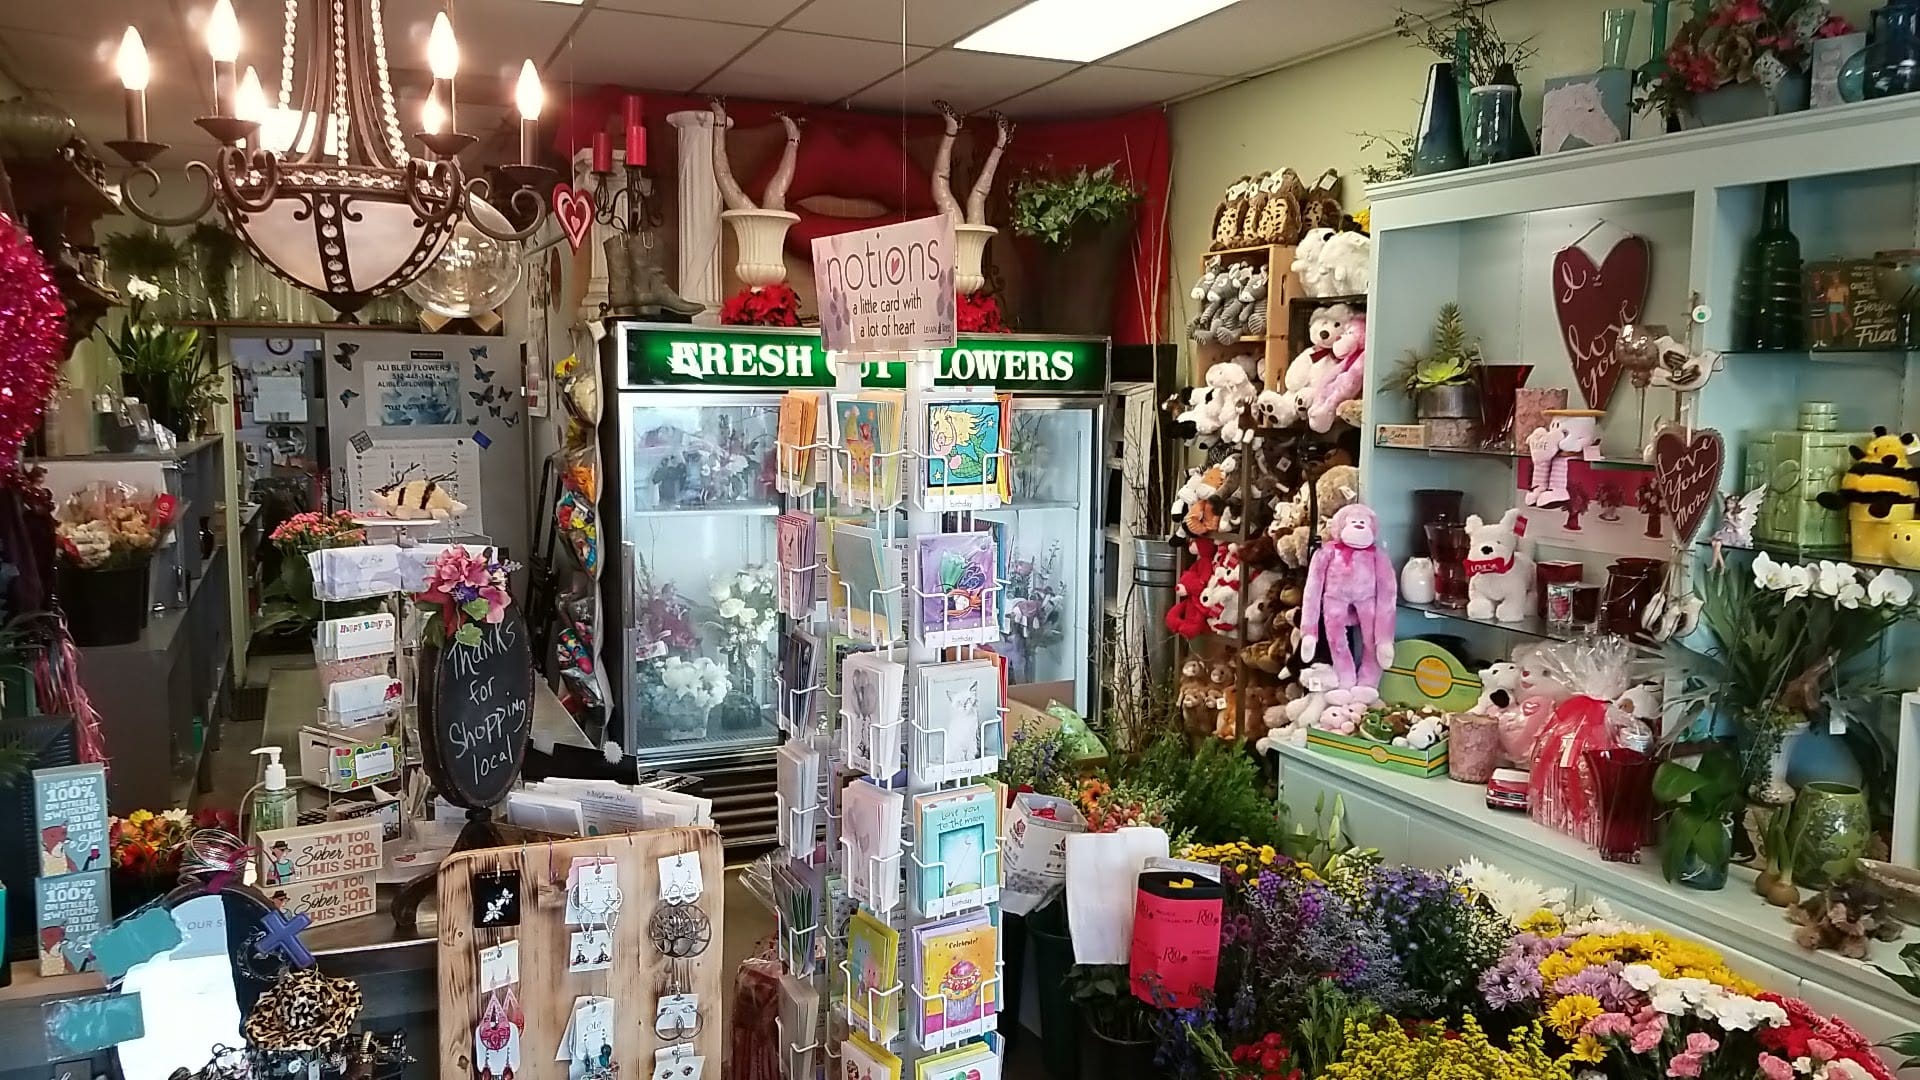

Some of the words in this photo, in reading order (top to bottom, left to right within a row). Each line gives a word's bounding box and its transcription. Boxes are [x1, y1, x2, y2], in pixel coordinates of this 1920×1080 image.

[826, 239, 940, 292] notions
[852, 302, 858, 315] a
[860, 293, 878, 314] little
[880, 289, 900, 309] card
[902, 287, 922, 310] with
[859, 326, 865, 337] a
[866, 316, 879, 337] lot
[881, 315, 891, 336] of
[893, 314, 916, 335] heart
[1853, 324, 1897, 347] Frien
[669, 342, 814, 379] FRESH
[931, 348, 1075, 381] LOWERS
[1657, 436, 1714, 485] Love
[1664, 460, 1718, 513] You
[1674, 490, 1710, 530] More
[447, 620, 516, 681] Thanks
[469, 676, 495, 706] for
[449, 691, 526, 759] Shopping
[473, 734, 514, 785] local
[45, 784, 96, 803] 100%
[69, 815, 82, 823] TO
[936, 822, 949, 831] to
[949, 817, 962, 829] the
[964, 814, 985, 825] moon
[941, 809, 959, 821] Love
[963, 805, 980, 818] you
[313, 834, 343, 847] I'M
[347, 831, 370, 844] TOO
[295, 845, 345, 867] Sober
[348, 842, 377, 856] FOR
[307, 861, 340, 876] THIS
[343, 854, 380, 871] SHIT
[45, 887, 95, 903] 100%
[312, 880, 339, 894] I'M
[343, 875, 364, 889] TOO
[293, 893, 341, 915] Sober
[343, 886, 371, 902] FOR
[309, 907, 336, 922] HIS
[339, 898, 374, 917] SHIT
[68, 916, 80, 924] TO
